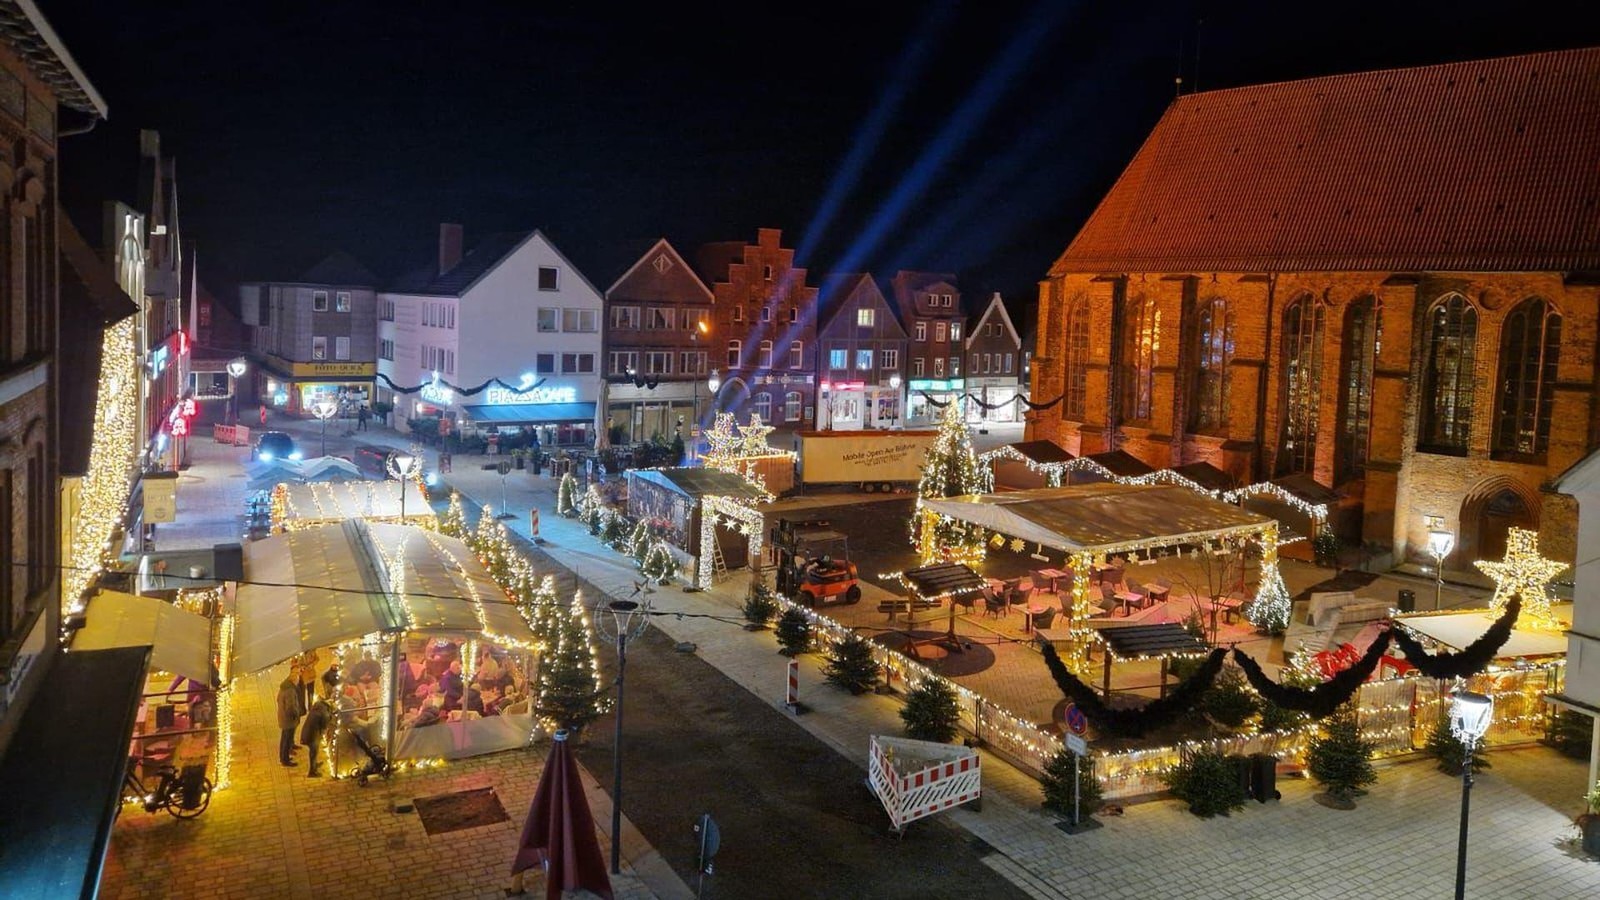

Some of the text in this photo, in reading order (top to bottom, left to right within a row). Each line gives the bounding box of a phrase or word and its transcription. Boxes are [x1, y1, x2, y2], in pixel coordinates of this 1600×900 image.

[489, 390, 542, 403] PIAZZA
[842, 453, 865, 461] Mobile
[866, 450, 884, 458] Open
